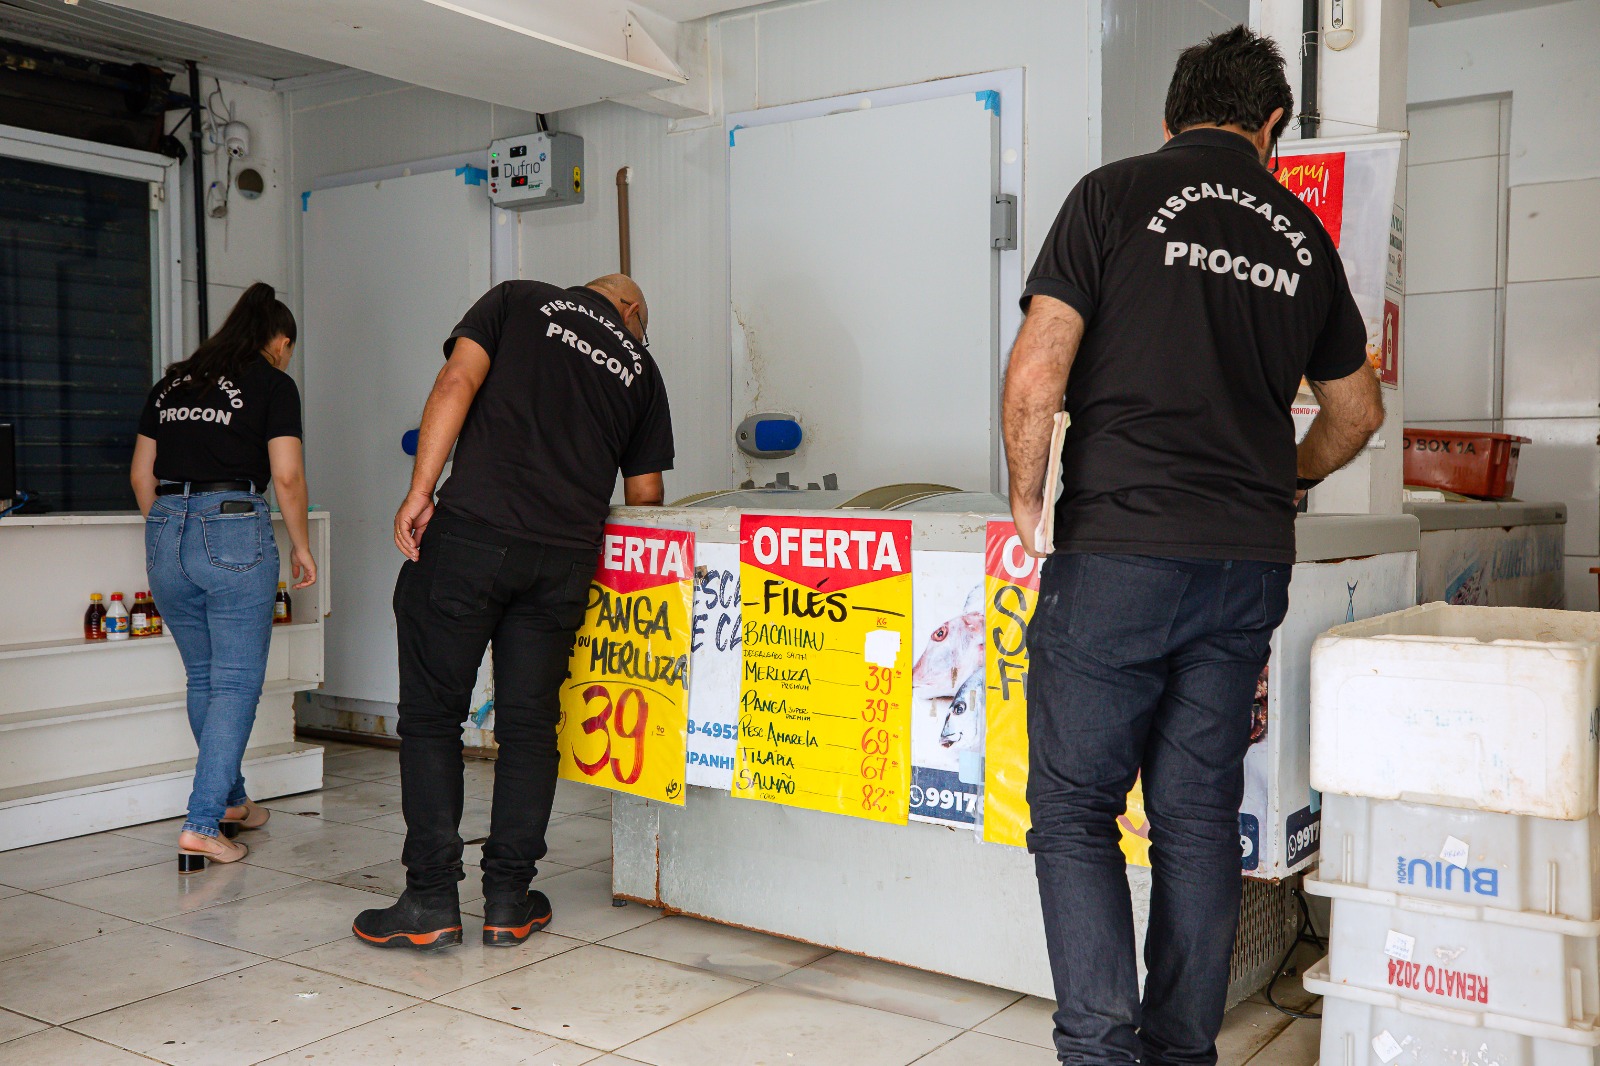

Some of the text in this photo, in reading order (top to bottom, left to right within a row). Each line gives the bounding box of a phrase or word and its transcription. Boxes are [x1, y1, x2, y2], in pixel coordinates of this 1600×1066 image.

[503, 160, 541, 178] Dufrio
[1278, 161, 1325, 190] Aqui
[1147, 182, 1312, 266] FISCALIZAÇÃO
[1164, 241, 1300, 297] PROCON
[540, 299, 643, 375] FISCALIZAÇÃO
[546, 322, 635, 388] PROCON
[159, 406, 233, 426] PROCON
[1416, 438, 1451, 453] BOX
[1457, 441, 1476, 455] 1A
[600, 534, 685, 578] ERTA
[752, 526, 903, 572] OFERTA
[1002, 534, 1048, 579] O
[586, 583, 672, 641] PANGA
[876, 617, 888, 626] KG
[589, 636, 689, 690] MERLUZA
[745, 660, 812, 685] MERLUZA
[571, 684, 649, 785] 39
[861, 726, 889, 756] 69
[861, 784, 888, 813] 82
[1407, 858, 1499, 897] BUIU
[1424, 965, 1489, 1004] RENATO
